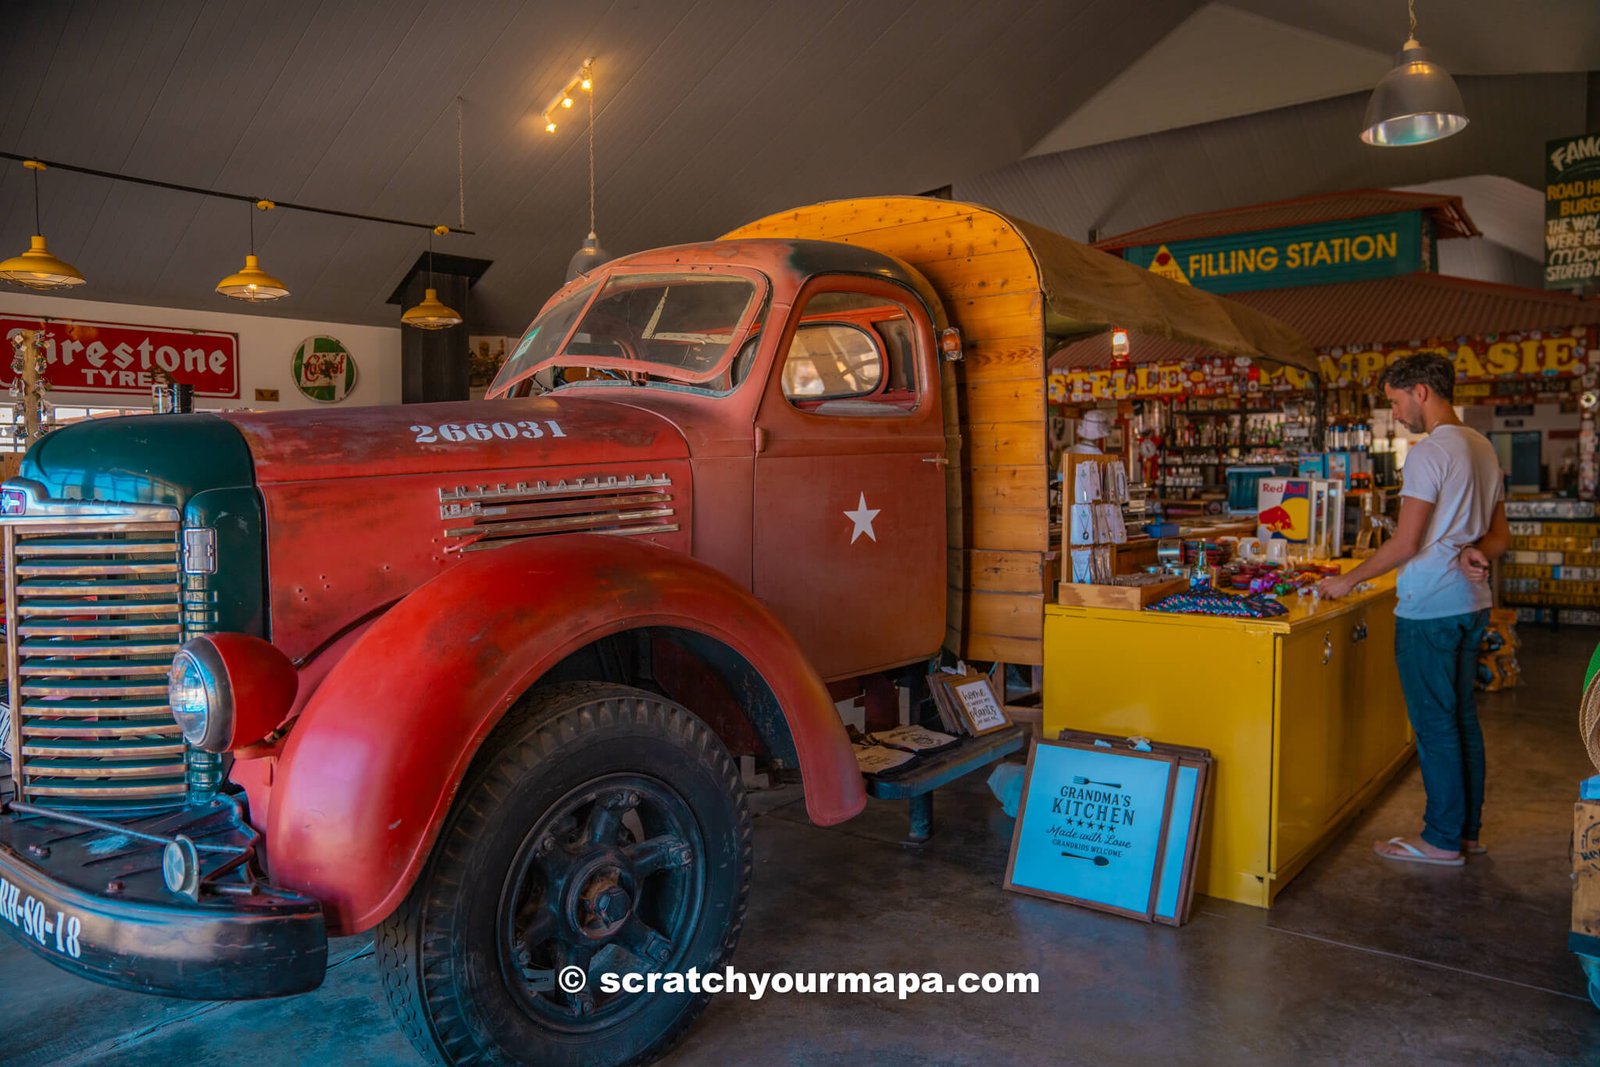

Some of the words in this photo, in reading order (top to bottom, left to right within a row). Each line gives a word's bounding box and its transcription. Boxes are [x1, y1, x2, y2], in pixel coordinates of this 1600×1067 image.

[1547, 181, 1584, 200] ROAD
[1547, 217, 1569, 234] THE
[1571, 214, 1600, 231] WAY
[1546, 231, 1582, 250] WERE
[1188, 246, 1279, 279] FILLING
[1286, 232, 1397, 268] STATION
[1546, 261, 1594, 282] STUFFED
[410, 420, 567, 443] 266031
[439, 473, 671, 497] INTERNATIONAL
[1262, 483, 1284, 494] Red
[1285, 483, 1307, 494] Bull
[961, 688, 986, 701] home
[970, 704, 998, 721] plants
[1060, 785, 1131, 808] GRANDMA'S
[1052, 797, 1135, 826] KITCHEN
[1046, 824, 1078, 840] Made
[1079, 831, 1102, 843] with
[1104, 834, 1132, 849] Love
[1051, 838, 1089, 852] GRANDKIDS
[1090, 845, 1122, 858] WELCOME
